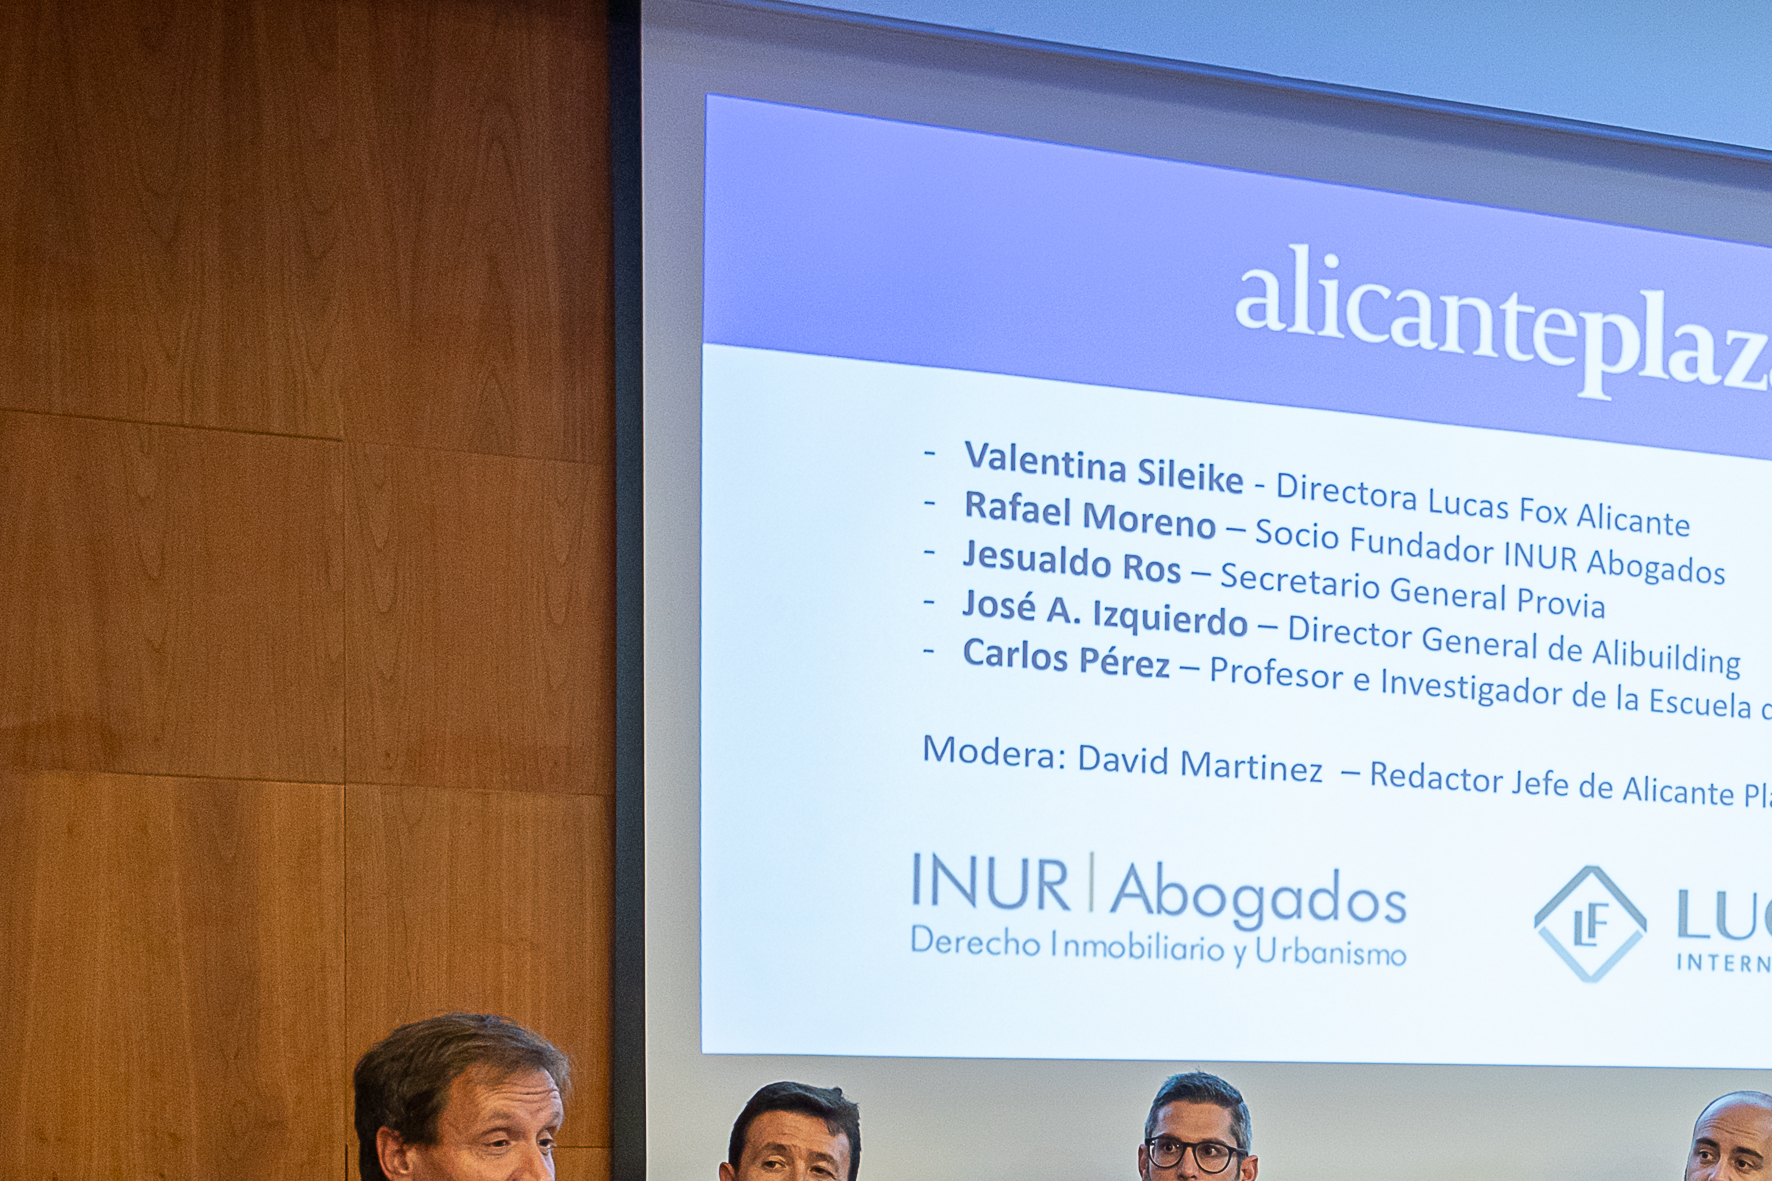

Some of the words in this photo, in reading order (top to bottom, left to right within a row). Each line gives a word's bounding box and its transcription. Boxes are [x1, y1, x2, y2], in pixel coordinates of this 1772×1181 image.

[964, 440, 1126, 483] Valentina
[1138, 458, 1244, 495] Sileike
[1277, 472, 1416, 511] Directora
[1429, 488, 1509, 520] Lucas
[1521, 497, 1568, 526] Fox
[1576, 502, 1690, 537] Alicante
[966, 490, 1071, 527] Rafael
[1084, 502, 1216, 540] Moreno
[1256, 518, 1339, 550] Socio
[1351, 526, 1495, 565] Fundador
[1505, 541, 1577, 572] INUR
[1586, 549, 1725, 585] Abogados
[963, 539, 1111, 579] Jesualdo
[1124, 553, 1181, 584] Ros
[1221, 562, 1380, 599] Secretario
[1390, 577, 1506, 611] General
[1518, 588, 1605, 619] Provia
[962, 589, 1036, 621] José
[1046, 596, 1081, 624] A.
[1094, 600, 1248, 637] Izquierdo
[1289, 615, 1413, 649] Director
[1422, 627, 1537, 659] General
[1548, 634, 1582, 662] de
[1592, 639, 1741, 681] Alibuilding
[963, 637, 1068, 672] Carlos
[1080, 645, 1170, 679] Pérez
[1211, 656, 1344, 690] Profesor
[1354, 673, 1370, 692] e
[1382, 668, 1563, 707] Investigador
[1572, 681, 1606, 709] de
[1617, 683, 1638, 711] la
[1651, 688, 1751, 719] Escuela
[924, 734, 1065, 770] Modera:
[1079, 744, 1168, 775] David
[1182, 750, 1323, 783] Martinez
[1371, 761, 1504, 793] Redactor
[1512, 769, 1569, 797] Jefe
[1579, 772, 1613, 799] de
[1623, 775, 1734, 806] Alicante
[912, 852, 1071, 912] INUR
[1109, 860, 1407, 933] Abogados
[911, 924, 1041, 957] Derecho
[1052, 929, 1225, 962] Inmobiliario
[1233, 945, 1247, 969] y
[1256, 936, 1407, 967] Urbanismo
